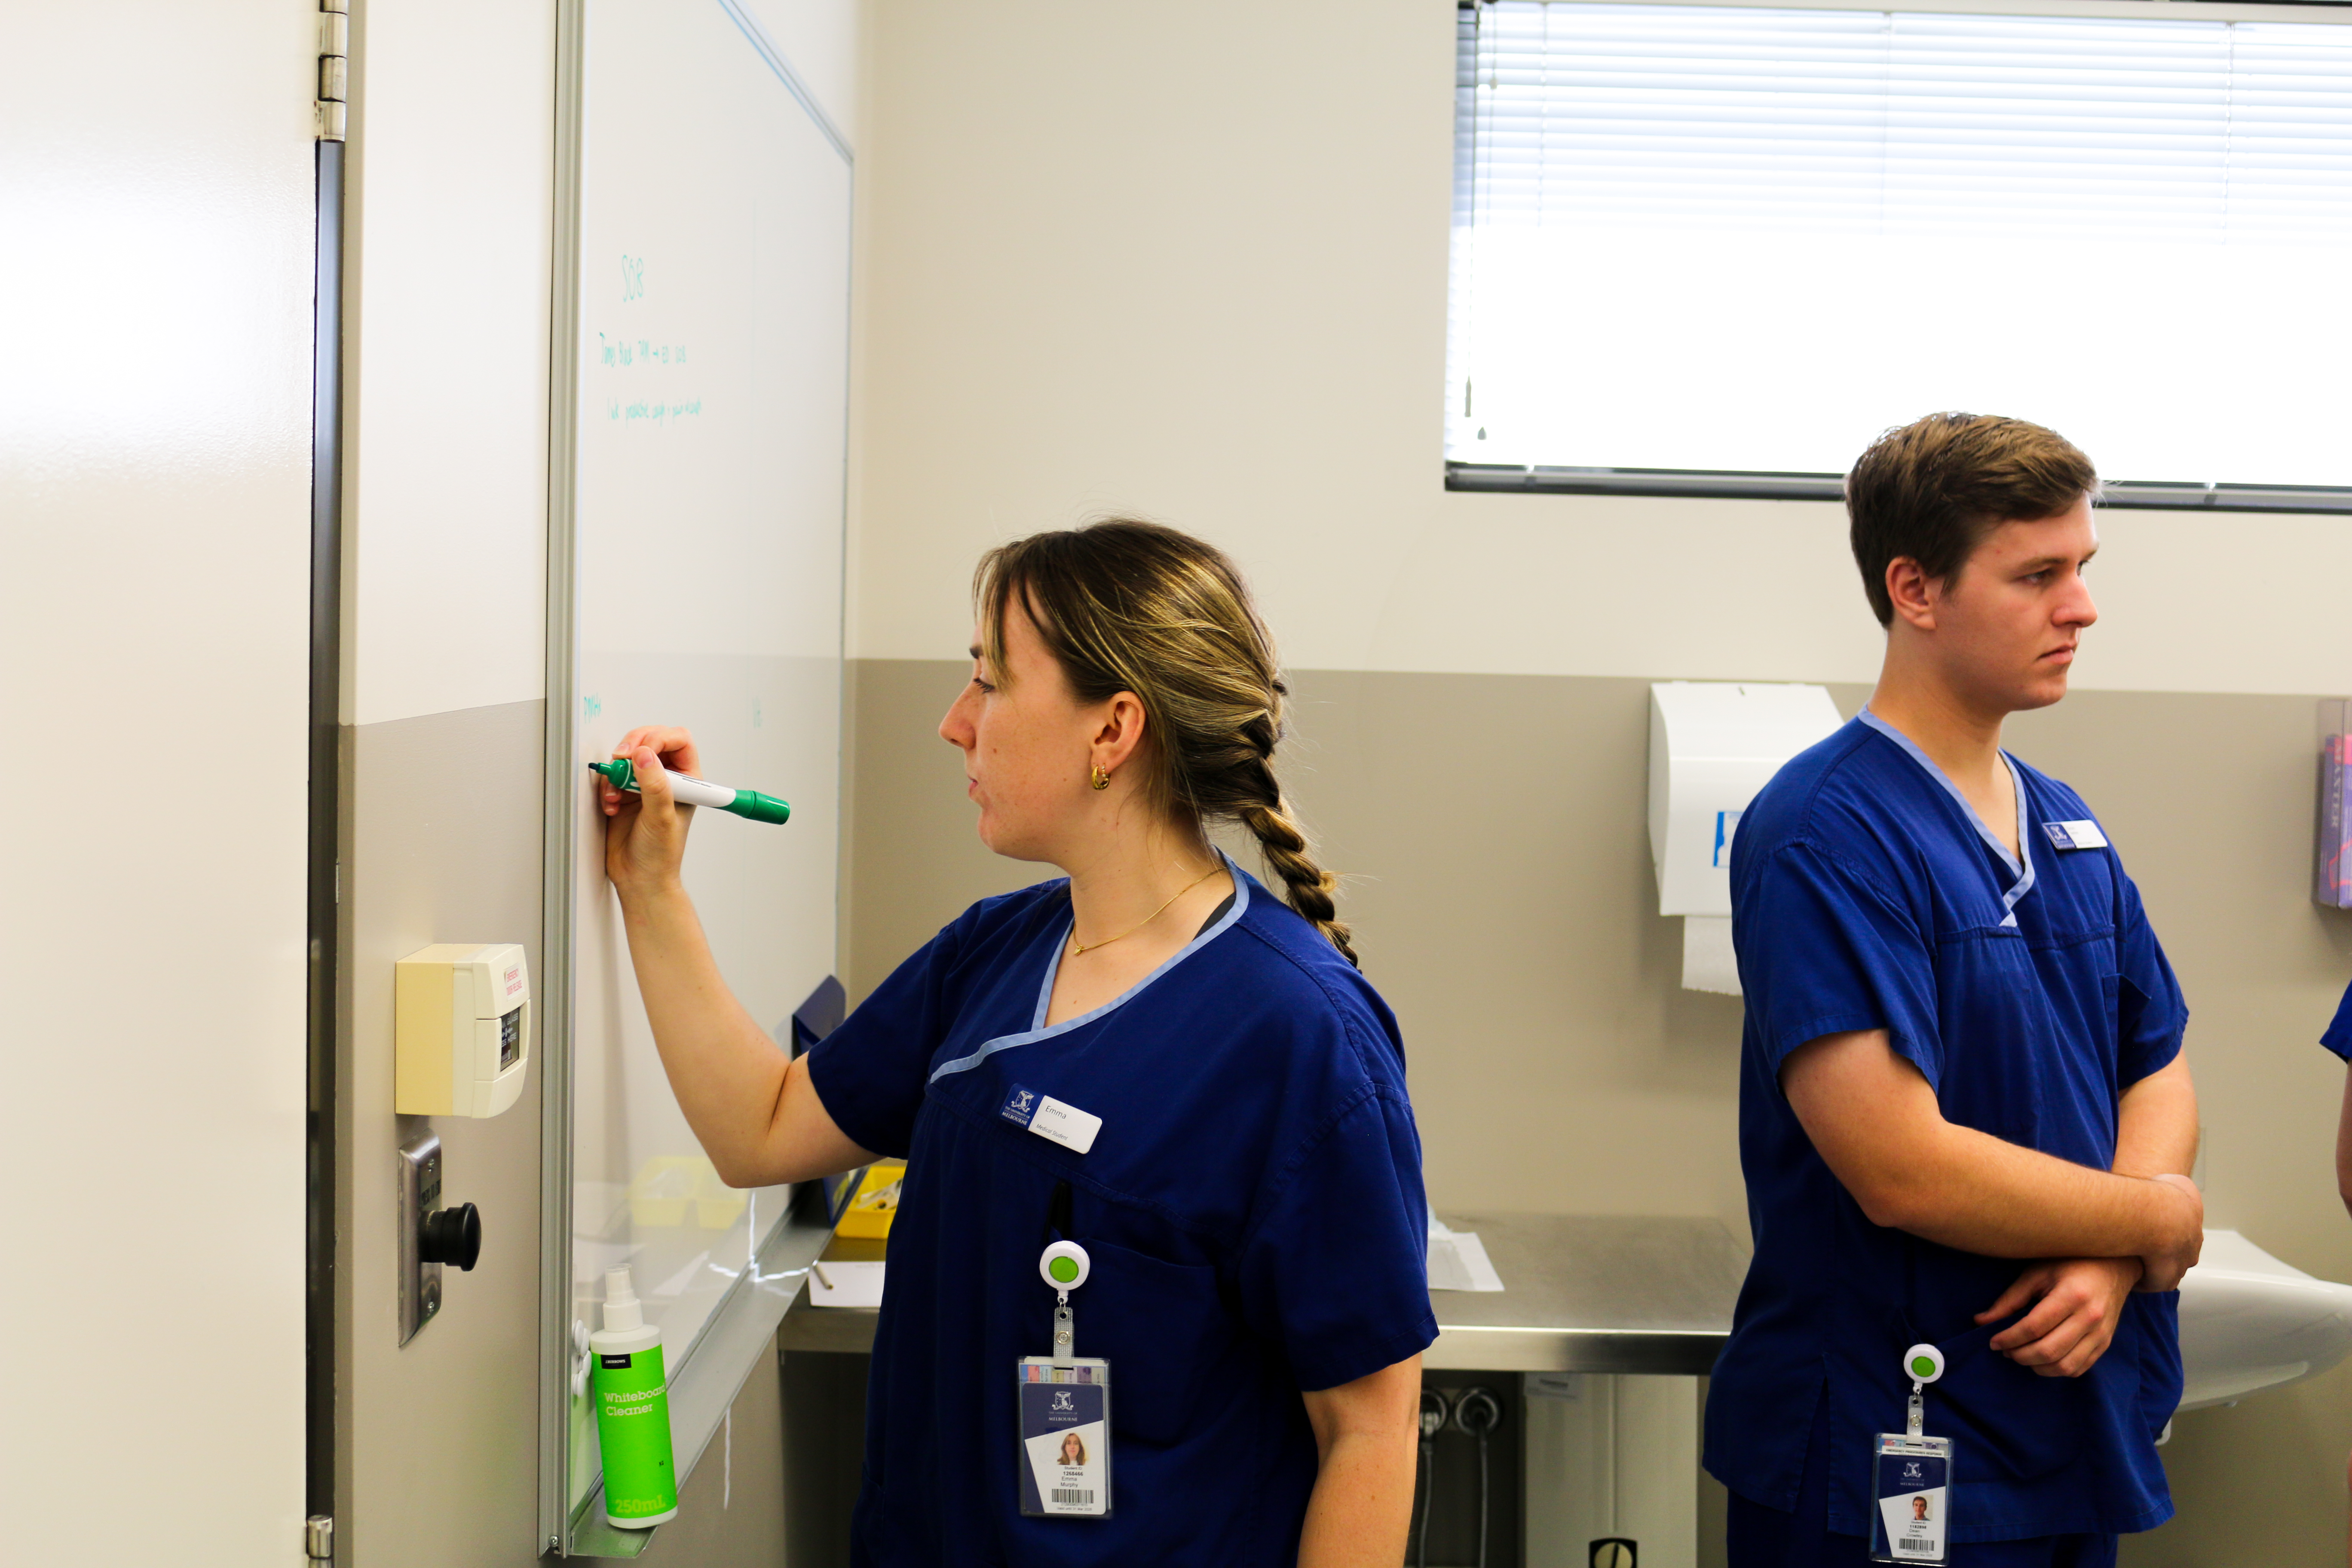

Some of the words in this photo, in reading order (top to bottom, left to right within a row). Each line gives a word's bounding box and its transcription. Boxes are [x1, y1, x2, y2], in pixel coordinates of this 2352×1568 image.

[622, 254, 644, 303] SOB
[1002, 1112, 1028, 1125] MELBOURNE
[1010, 1109, 1026, 1118] UNIVERSITY
[1045, 1106, 1066, 1119] Emma
[1036, 1124, 1053, 1133] Medical
[1052, 1130, 1068, 1141] Student
[603, 1383, 665, 1403] Whiteboard
[606, 1404, 653, 1416] Cleaner
[615, 1494, 666, 1513] 250mL
